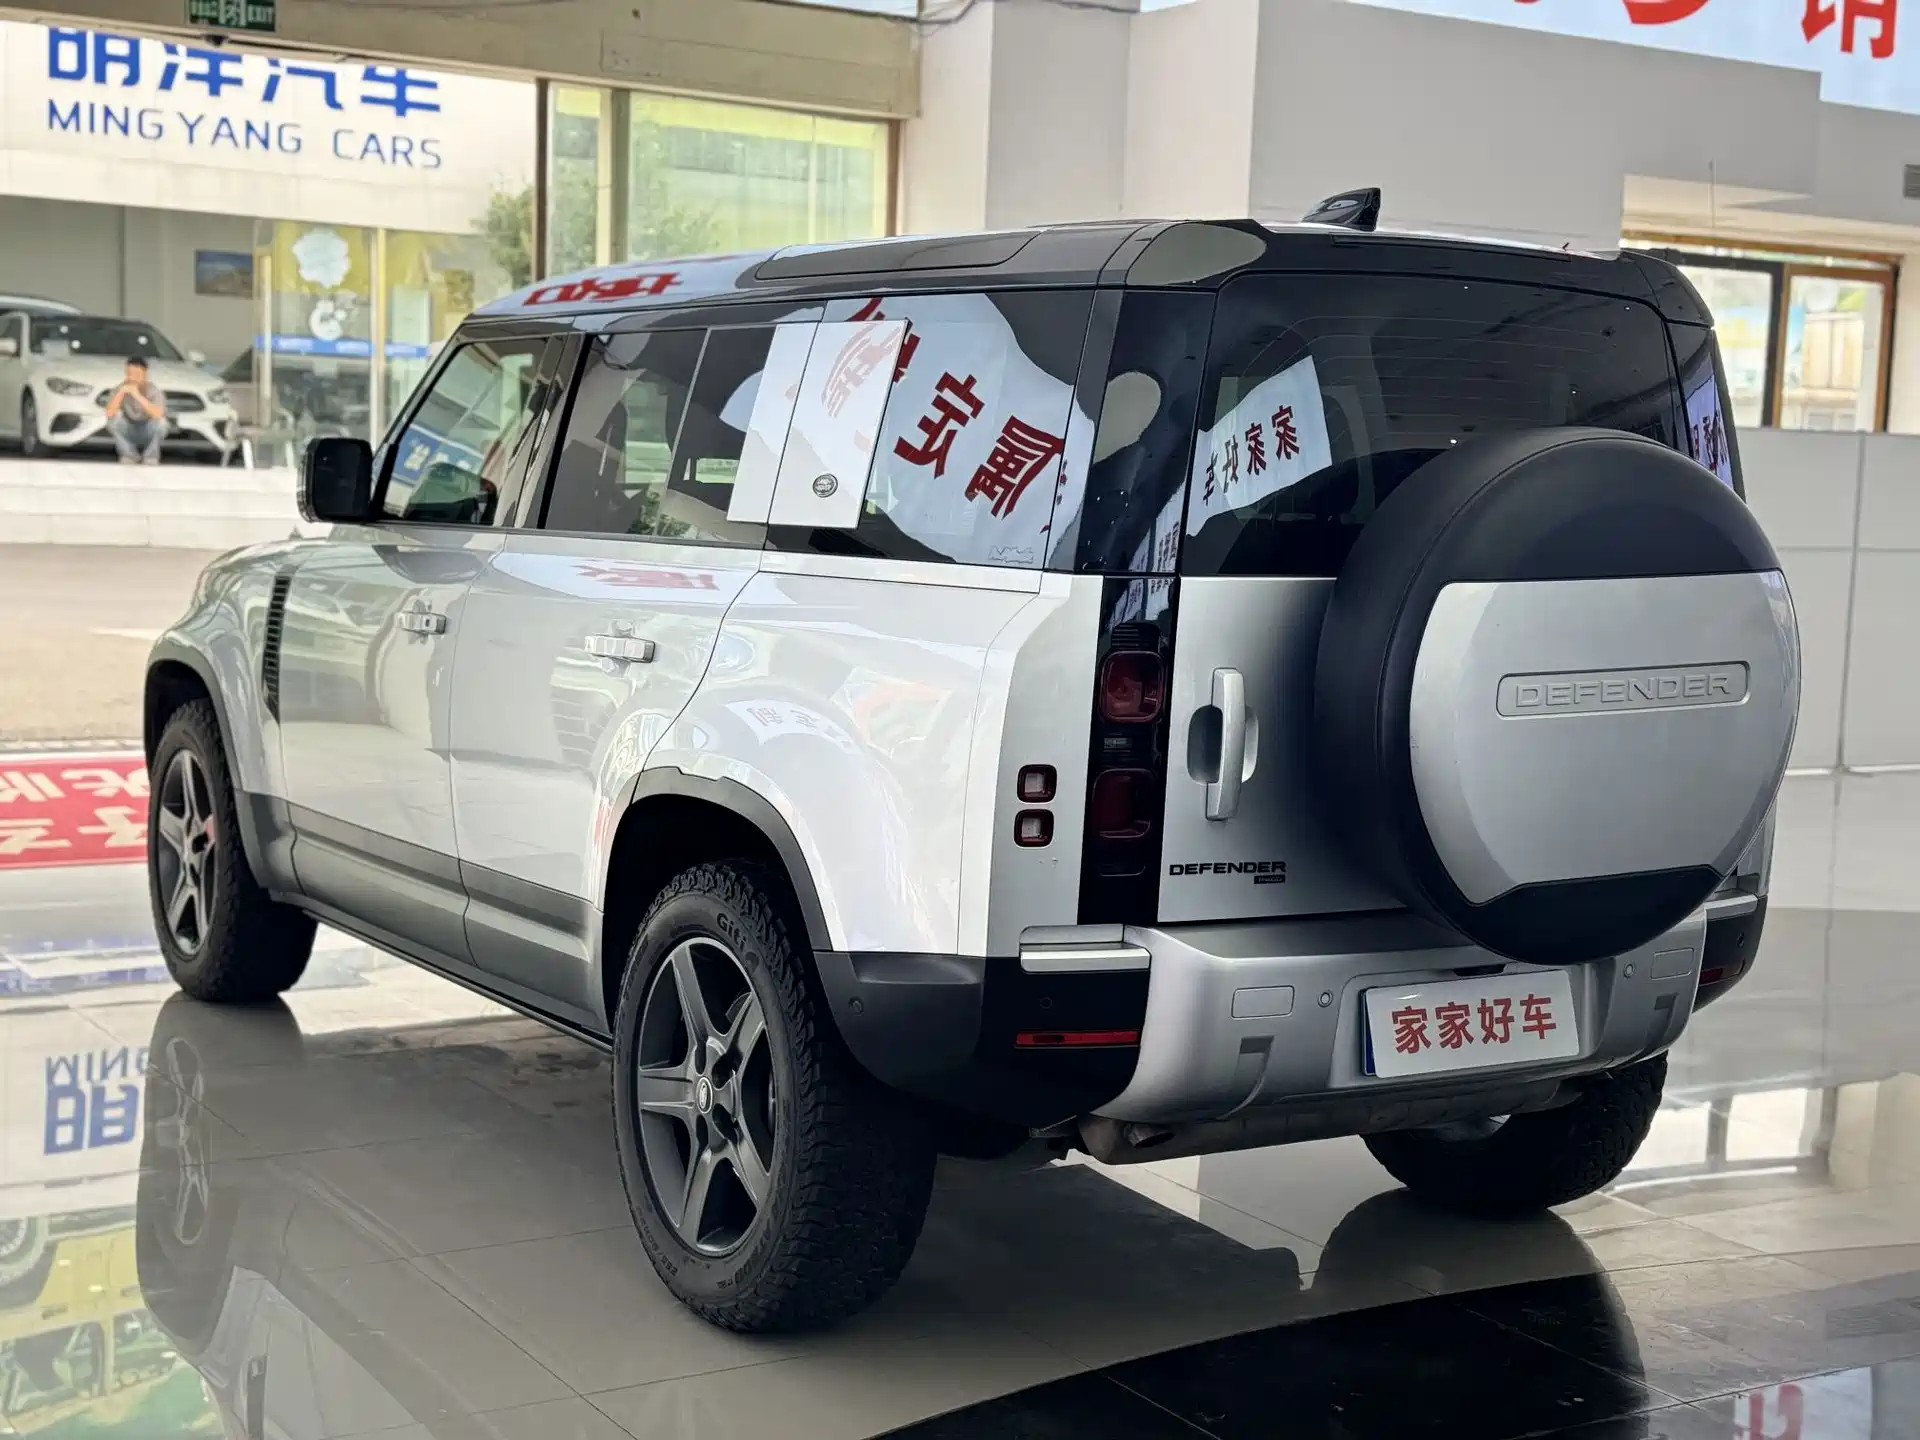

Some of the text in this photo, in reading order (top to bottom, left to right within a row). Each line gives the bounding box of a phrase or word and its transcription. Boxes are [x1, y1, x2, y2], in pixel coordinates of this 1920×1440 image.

[48, 98, 442, 170] MING YANG CARS
[1515, 672, 1732, 708] DEFENDER
[1169, 860, 1287, 876] DEFENDER
[716, 911, 748, 953] Giti
[1391, 993, 1557, 1055] 家家好车
